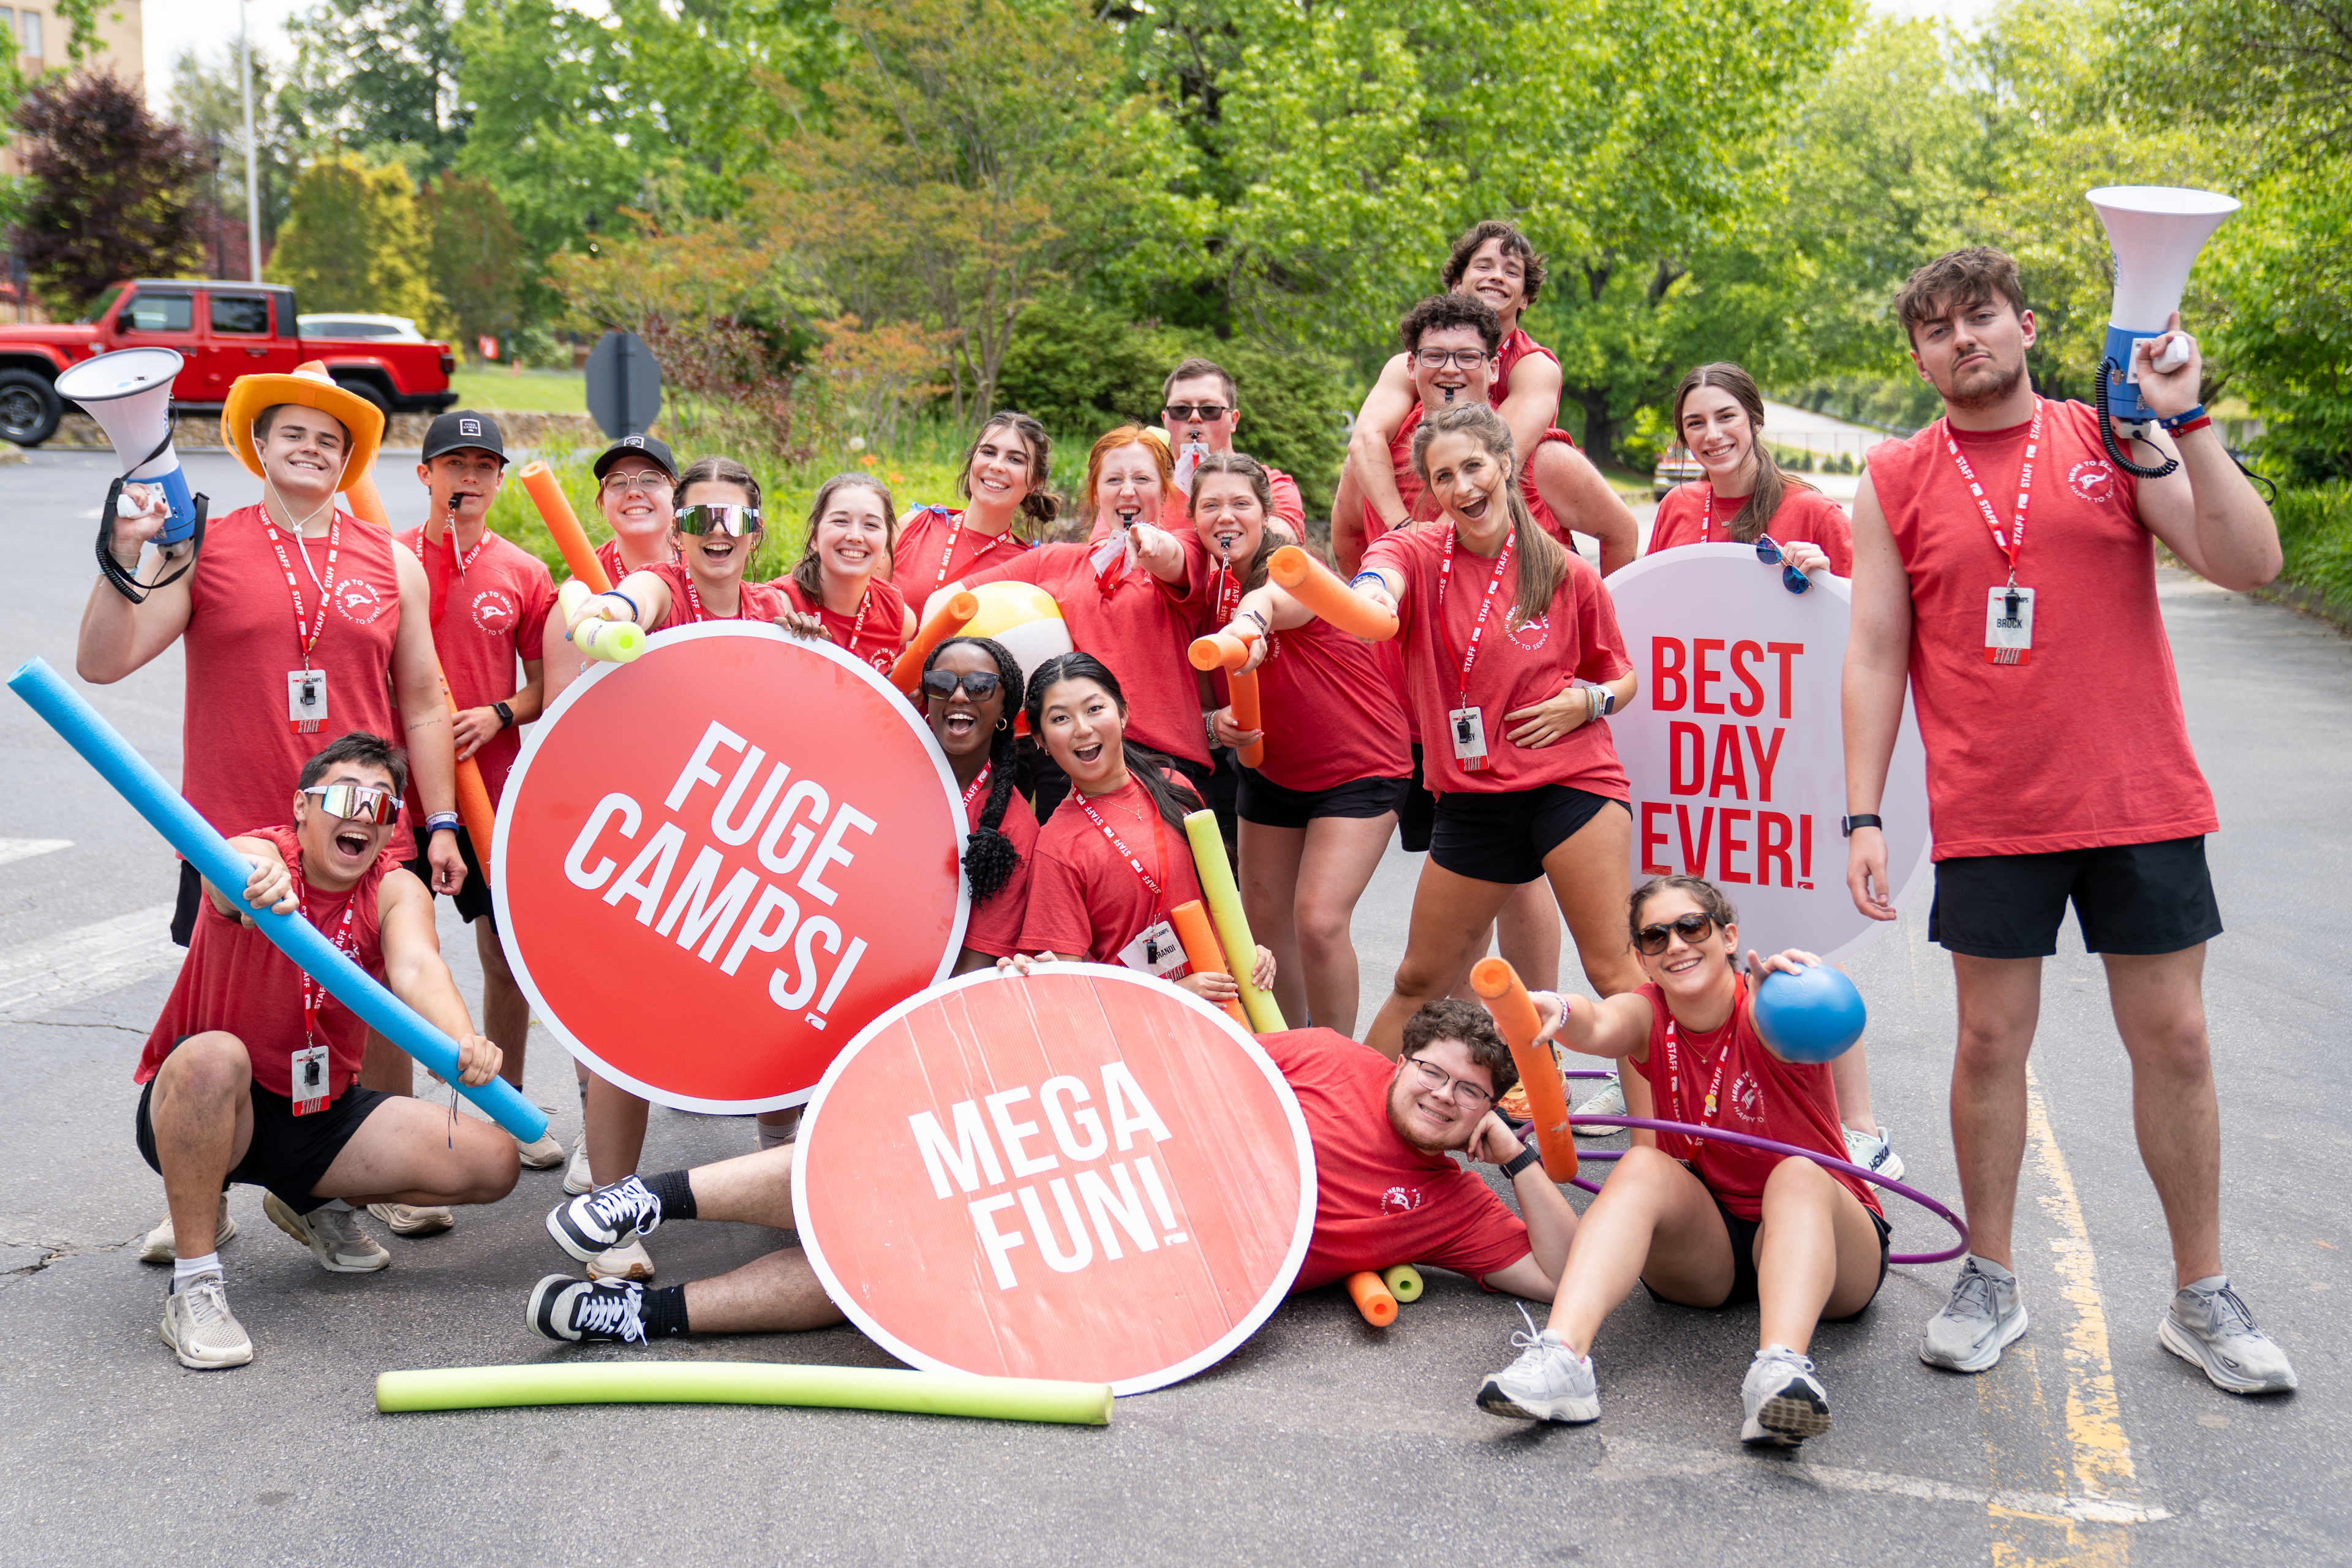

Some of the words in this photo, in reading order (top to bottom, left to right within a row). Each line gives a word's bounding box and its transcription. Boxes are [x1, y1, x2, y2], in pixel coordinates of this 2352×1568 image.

[2029, 413, 2043, 440] STAFF
[2021, 463, 2034, 488] STAFF
[2068, 464, 2083, 482] HERE
[1956, 456, 1974, 480] STAFF
[1979, 499, 1999, 524] STAFF
[2070, 484, 2092, 501] HAPPY
[331, 524, 340, 545] STAFF
[954, 515, 963, 532] STAFF
[2013, 514, 2025, 546] STAFF
[258, 507, 271, 526] STAFF
[275, 545, 290, 568] STAFF
[292, 590, 304, 616] STAFF
[464, 545, 481, 564] STAFF
[941, 548, 952, 567] STAFF
[1494, 551, 1509, 576] STAFF
[324, 566, 334, 589] STAFF
[614, 557, 627, 581] STAFF
[334, 579, 350, 597] HERE
[365, 583, 380, 603] HELP
[472, 591, 488, 608] HERE
[500, 597, 514, 614] HELP
[688, 584, 700, 609] STAFF
[335, 600, 353, 622] HAPPY
[366, 606, 380, 624] SERVE
[472, 611, 487, 632] HAPPY
[855, 607, 866, 631] STAFF
[1219, 605, 1229, 623] STAFF
[1477, 598, 1491, 622] STAFF
[313, 610, 326, 637] STAFF
[1997, 618, 2022, 628] BROCK
[1532, 633, 1548, 650] SERVE
[869, 649, 881, 664] HERE
[1463, 646, 1476, 673] STAFF
[1994, 648, 2022, 665] STAFF
[1652, 636, 1804, 719] BEST
[298, 720, 320, 733] STAFF
[1463, 757, 1482, 771] STAFF
[1670, 721, 1785, 802] DAY
[663, 720, 878, 907] FUGE
[1084, 806, 1104, 826] STAFF
[1113, 839, 1131, 857] STAFF
[1142, 875, 1162, 894] STAFF
[1641, 801, 1814, 890] EVER!
[564, 792, 868, 1031] CAMPS!
[1156, 944, 1177, 961] RANDI
[1166, 964, 1186, 982] STAFF
[1667, 1042, 1678, 1071] STAFF
[1709, 1066, 1722, 1096] STAFF
[1732, 1078, 1744, 1102] HERE
[301, 1097, 322, 1115] STAFF
[1733, 1106, 1755, 1123] HAPPY
[908, 1061, 1172, 1200] MEGA
[1869, 1145, 1889, 1172] HOKA
[968, 1156, 1188, 1290] FUN!
